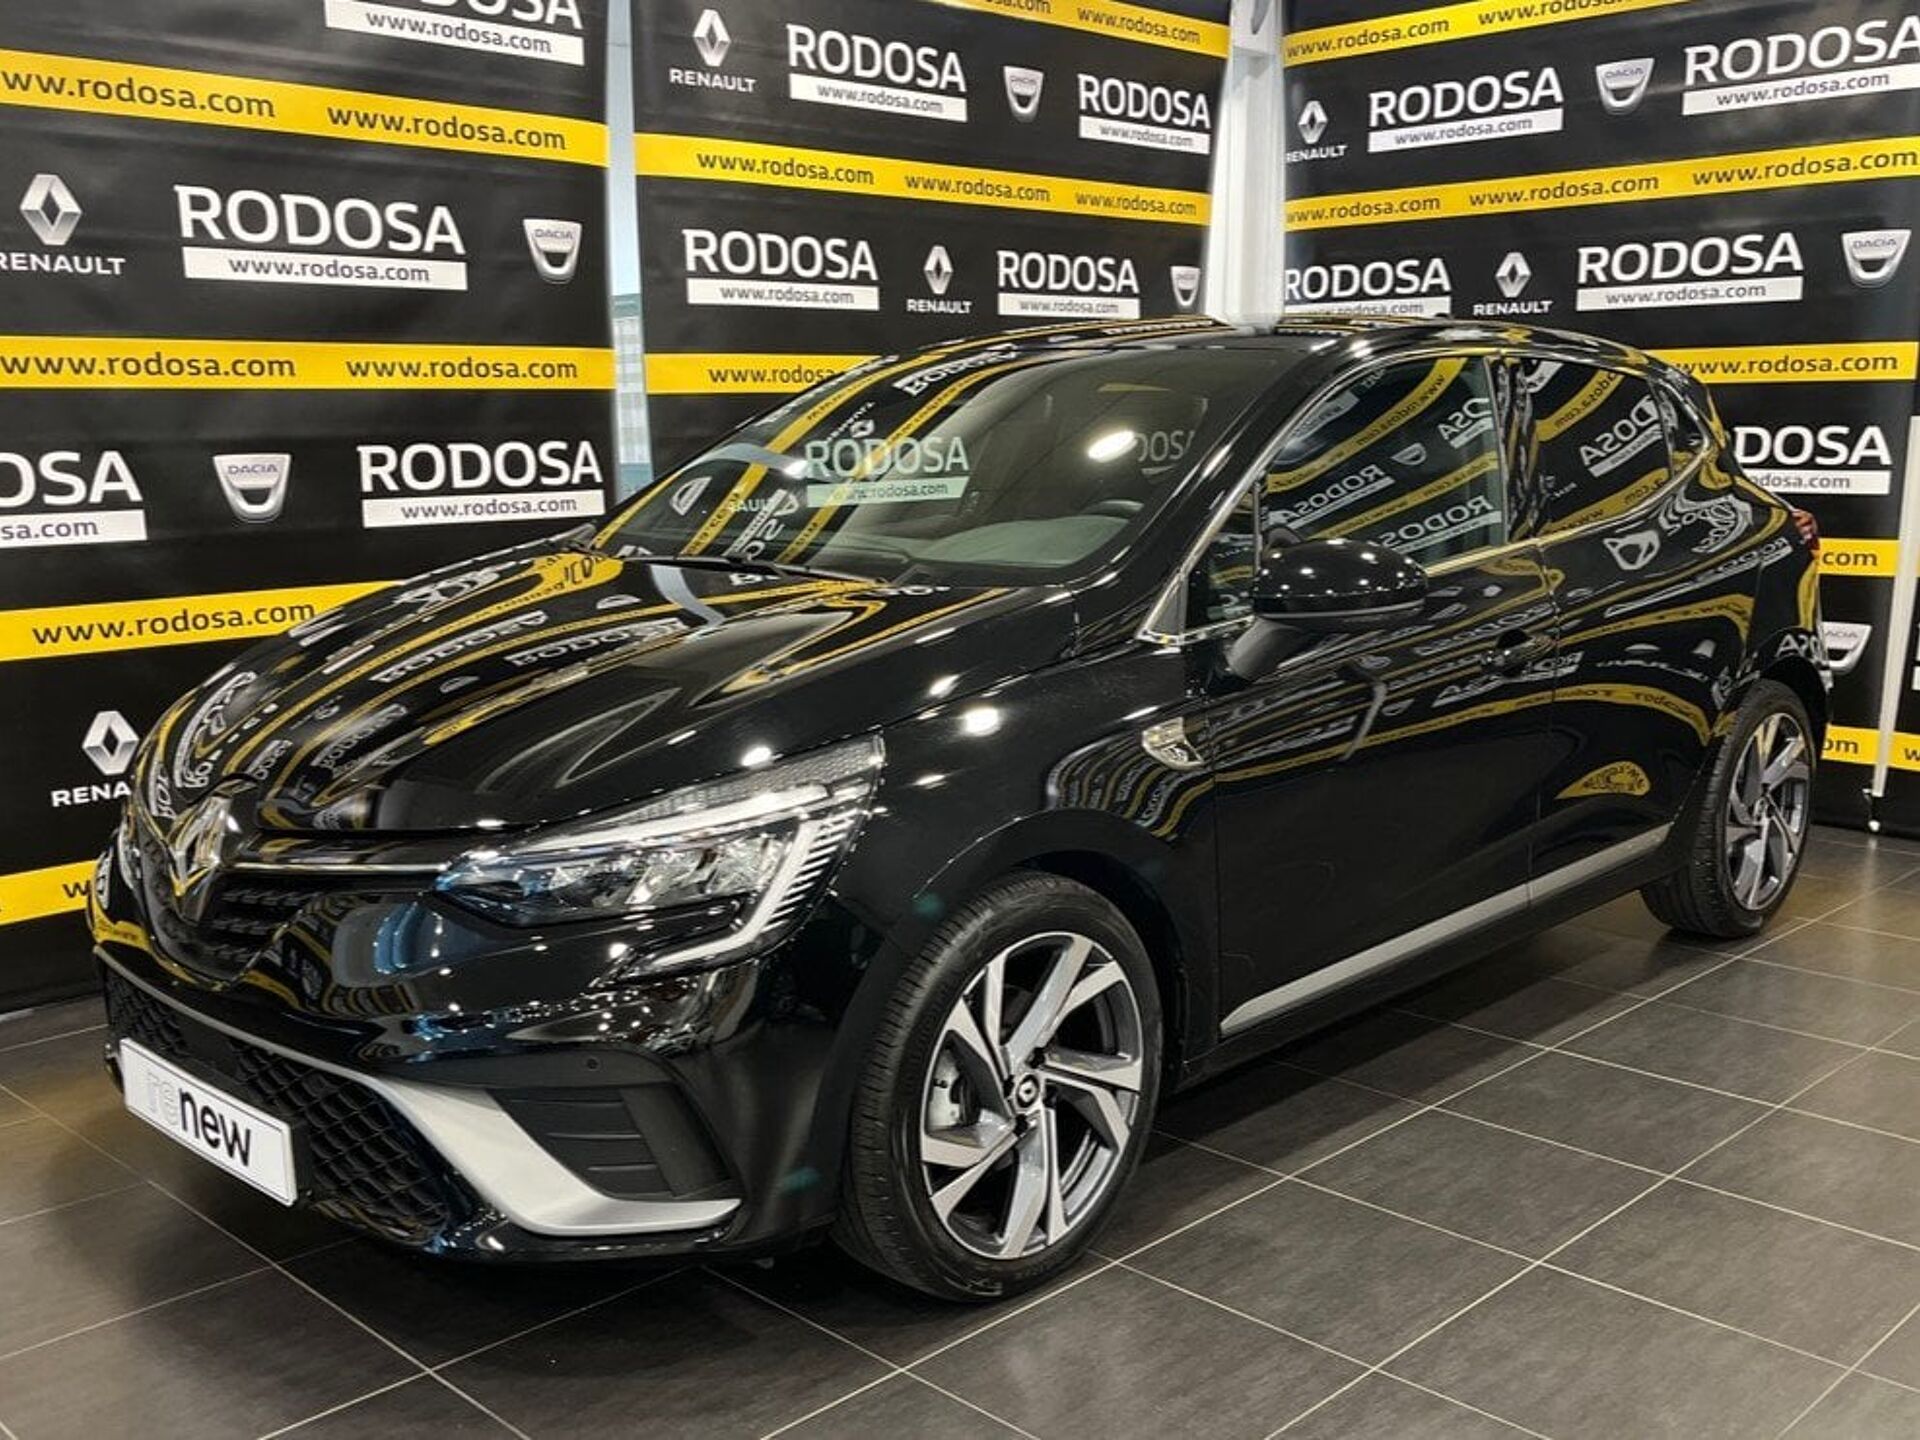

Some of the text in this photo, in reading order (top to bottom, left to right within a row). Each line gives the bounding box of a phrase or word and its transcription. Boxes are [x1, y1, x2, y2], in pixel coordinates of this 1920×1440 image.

[366, 12, 552, 53] www.rodosa.com
[1077, 6, 1200, 43] www.rodosa.com
[1286, 18, 1450, 57] www.rodosa.com
[786, 23, 967, 93] RODOSA
[1684, 15, 1920, 86] RODOSA
[669, 68, 757, 92] RENAULT
[1369, 67, 1564, 127] RODOSA
[1716, 71, 1890, 105] www.rodosa.com
[817, 82, 943, 114] www.rodosa.com
[1077, 73, 1211, 129] RODOSA
[327, 107, 566, 150] www.rodosa.com
[1395, 117, 1533, 145] www.rodosa.com
[697, 153, 874, 185] www.rodosa.com
[1692, 151, 1918, 186] www.rodosa.com
[905, 174, 1050, 201] www.rodosa.com
[1075, 190, 1197, 216] www.rodosa.com
[1469, 174, 1659, 207] www.rodosa.com
[173, 184, 467, 255] RODOSA
[228, 257, 430, 283] www.rodosa.com
[682, 229, 878, 281] RODOSA
[996, 250, 1140, 294] RODOSA
[1577, 232, 1804, 284] RODOSA
[720, 285, 854, 304] www.rodosa.com
[1285, 258, 1451, 300] RODOSA
[1605, 283, 1766, 304] www.rodosa.com
[907, 299, 972, 315] RENAULT
[1473, 301, 1553, 316] RENAULT
[0, 352, 296, 378] www.rodosa.com
[346, 357, 578, 378] www.rodosa.com
[805, 436, 969, 478] RODOSA
[1734, 425, 1892, 466] DOSA
[227, 463, 278, 475] DACIA
[356, 441, 603, 493] RODOSA
[401, 496, 577, 518] www.rodosa.com
[32, 603, 315, 645] www.rodosa.com
[51, 781, 131, 807] RENA
